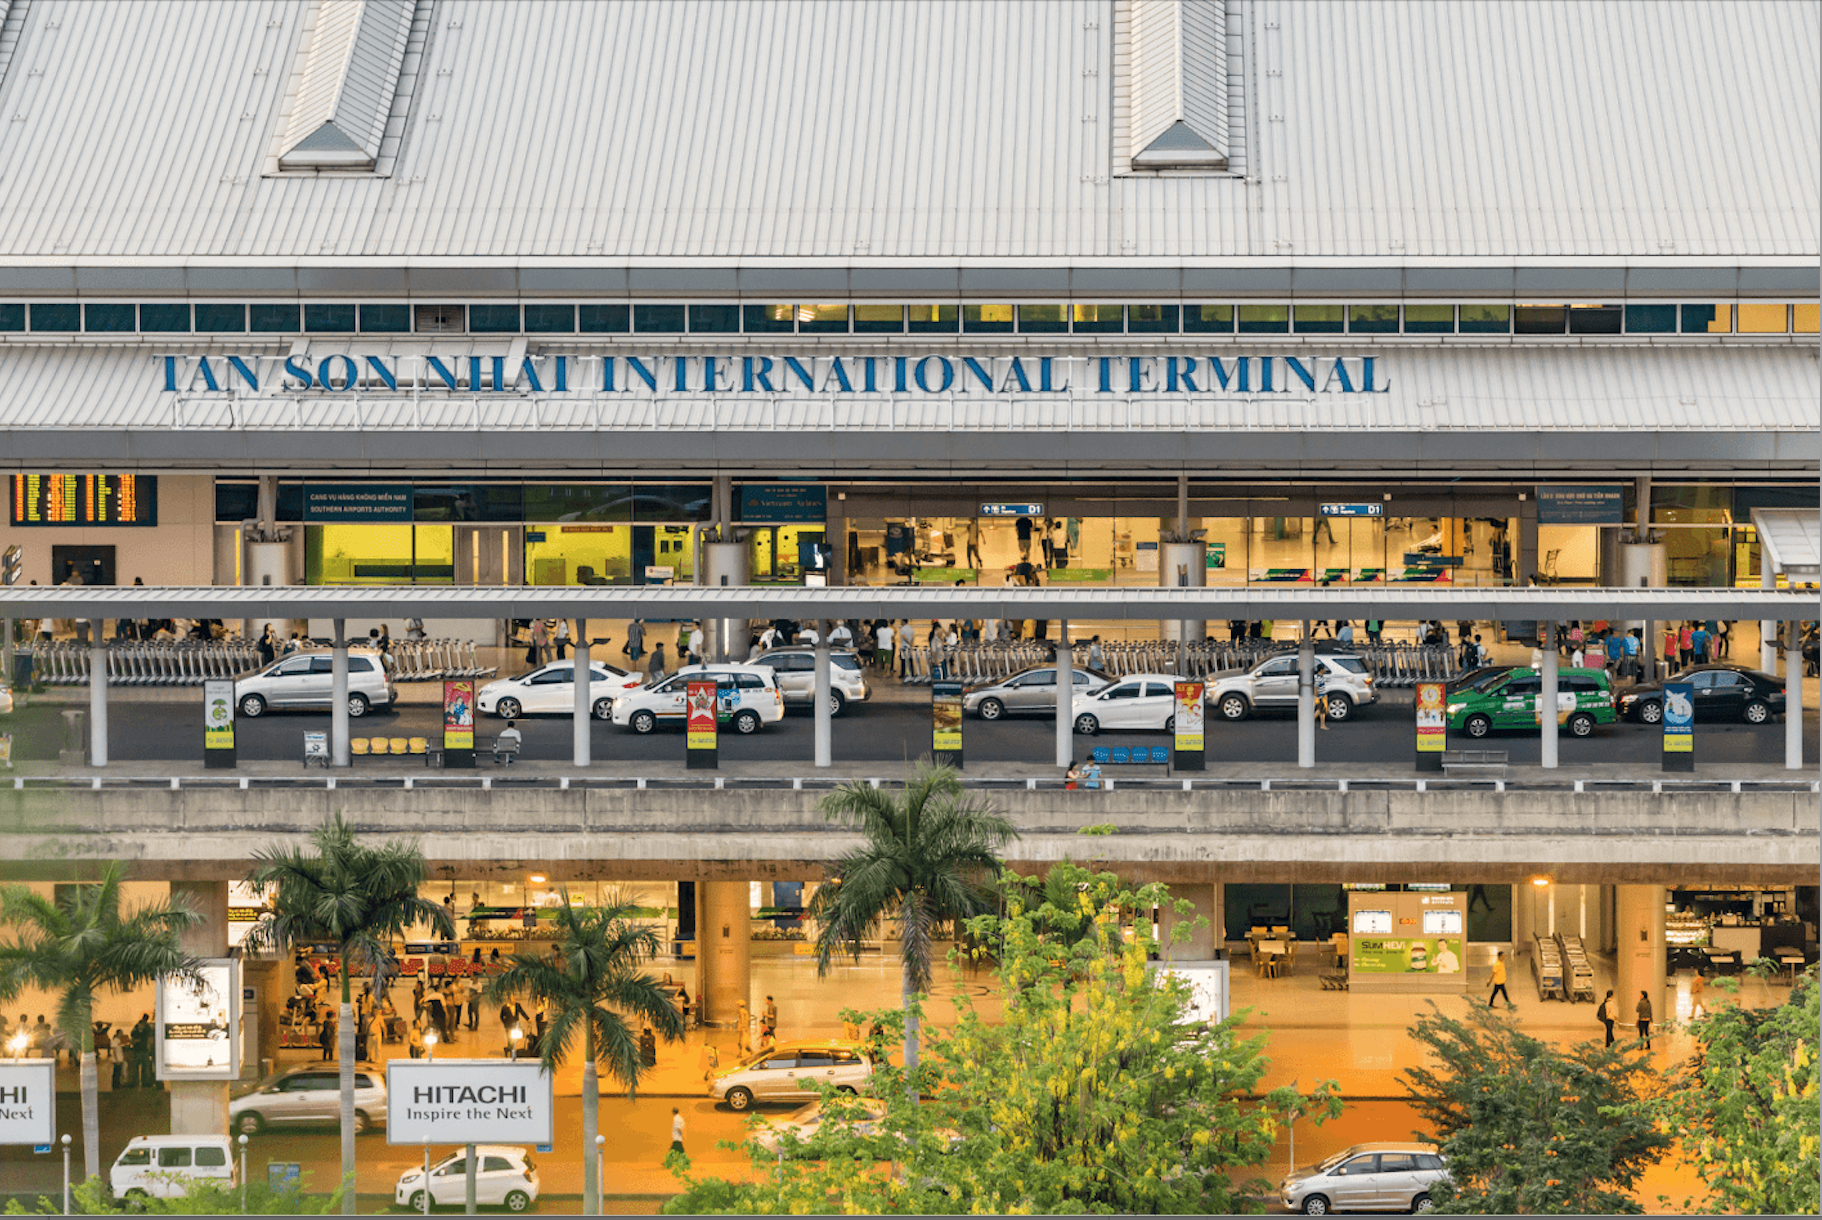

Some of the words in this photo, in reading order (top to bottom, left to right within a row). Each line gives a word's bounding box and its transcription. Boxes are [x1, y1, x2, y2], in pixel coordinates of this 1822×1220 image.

[152, 353, 263, 393] TAN
[282, 353, 399, 392] SON
[600, 354, 1069, 393] INTERNATIONAL
[1087, 354, 1391, 393] TERMINAL
[1028, 504, 1041, 514] D1
[1367, 504, 1380, 514] D1
[414, 1085, 526, 1104] HITACHI
[407, 1107, 461, 1122] Inspire
[467, 1107, 491, 1120] the
[496, 1106, 533, 1120] Next
